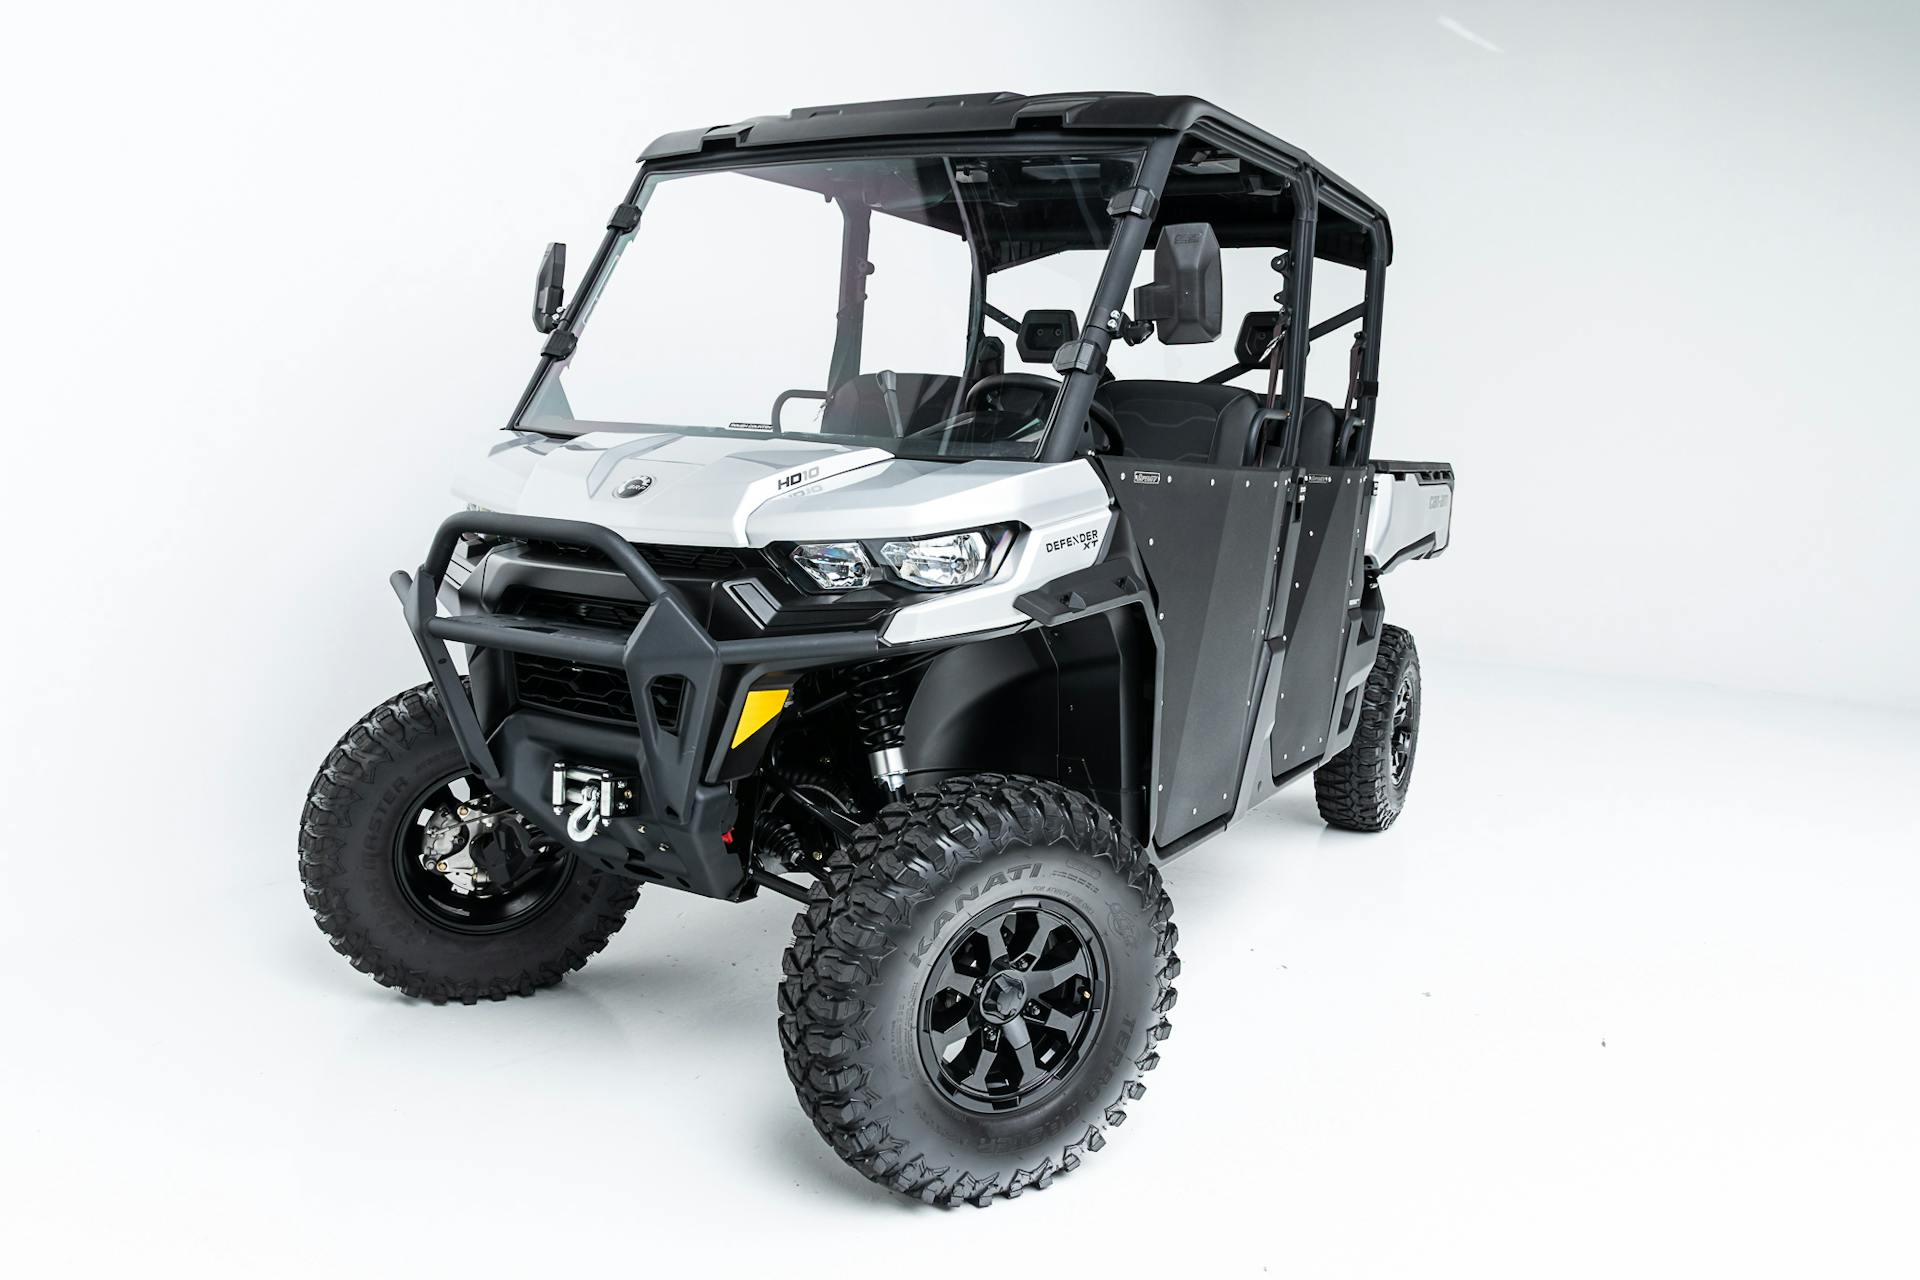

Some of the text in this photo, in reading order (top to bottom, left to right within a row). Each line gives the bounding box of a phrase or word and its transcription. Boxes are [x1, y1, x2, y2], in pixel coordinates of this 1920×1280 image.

[777, 466, 820, 491] HD10
[1045, 529, 1099, 553] DEFENDER
[1082, 539, 1099, 551] XT
[908, 862, 1043, 969] KANATI
